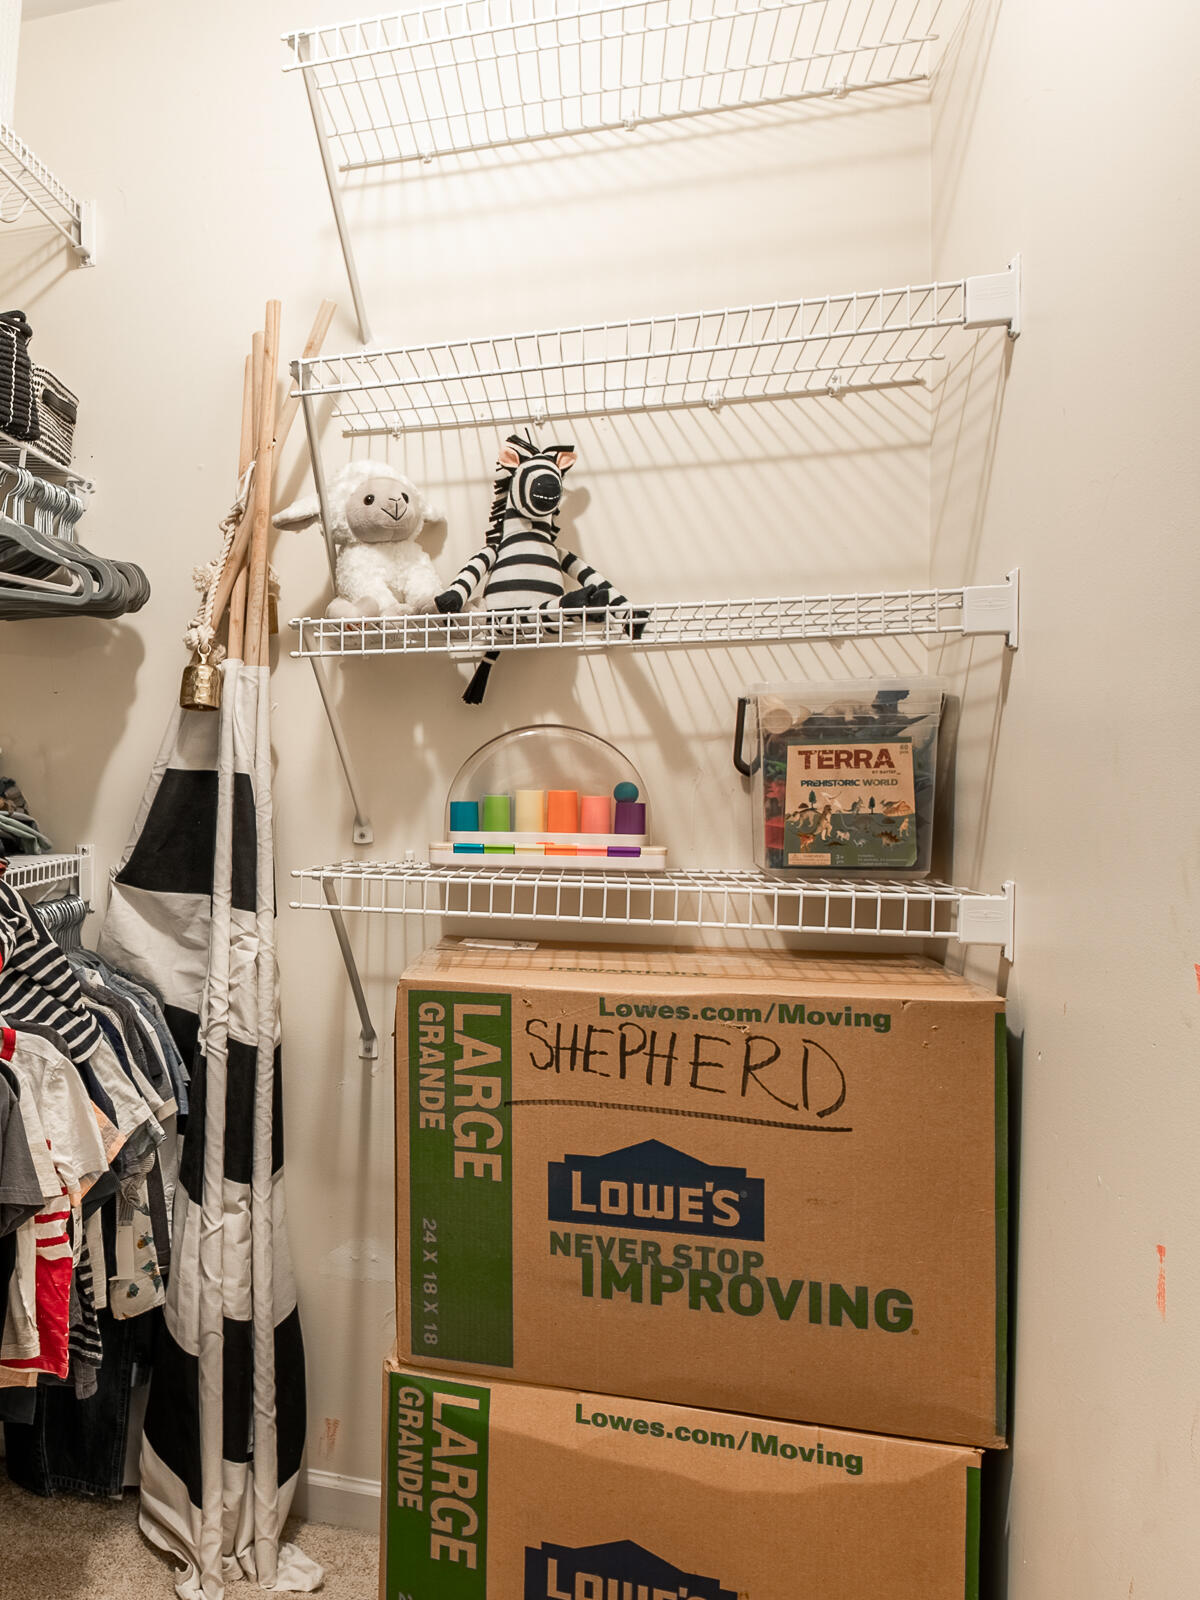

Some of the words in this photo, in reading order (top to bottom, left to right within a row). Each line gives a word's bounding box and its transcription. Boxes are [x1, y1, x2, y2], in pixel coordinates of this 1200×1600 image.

[797, 748, 895, 770] TERRA
[800, 779, 860, 787] PREHISTORIC
[862, 778, 898, 786] WORLD
[598, 996, 892, 1034] Lowes.com/Moving
[418, 1001, 446, 1131] GRANDE
[525, 1018, 848, 1118] SHEPHERD
[452, 1003, 504, 1182] LARGE
[571, 1169, 742, 1228] LOWE'S
[423, 1217, 438, 1243] 24
[549, 1230, 662, 1266] NEVER
[671, 1243, 765, 1278] STOP
[423, 1249, 439, 1265] X
[423, 1271, 439, 1295] 18
[580, 1252, 914, 1334] IMPROVING
[423, 1300, 440, 1315] X
[423, 1323, 440, 1345] 18
[397, 1386, 425, 1512] GRANDE
[575, 1403, 864, 1476] Lowes.com/Moving
[430, 1391, 480, 1570] LARGE
